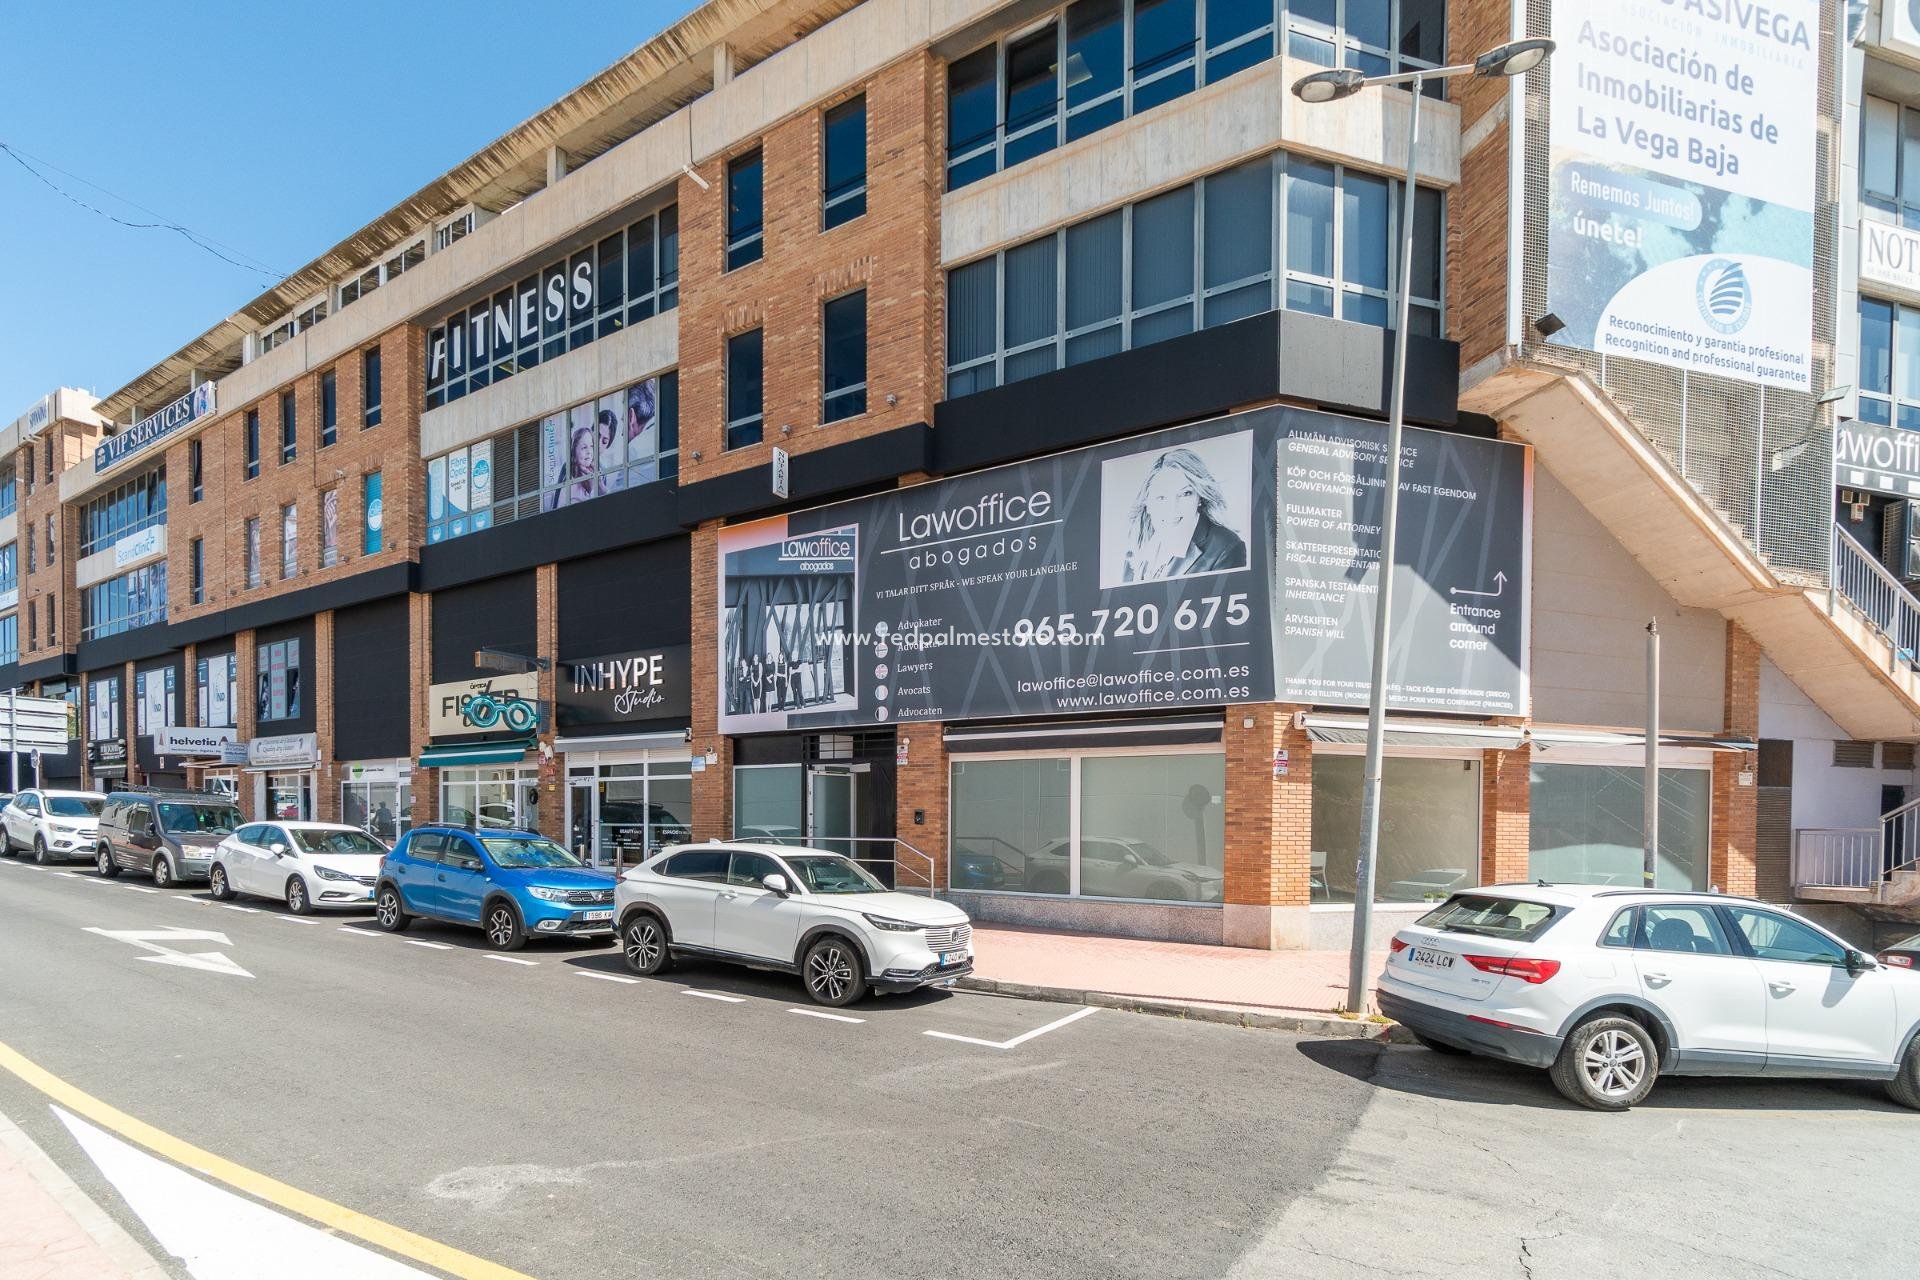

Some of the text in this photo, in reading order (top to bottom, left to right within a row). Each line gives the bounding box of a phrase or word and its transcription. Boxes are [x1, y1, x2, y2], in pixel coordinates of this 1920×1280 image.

[1577, 20, 1754, 95] Asociación de
[1577, 62, 1778, 144] Inmobiliarias de
[1577, 106, 1739, 176] La Vega Baja
[1571, 171, 1695, 222] Rememos Juntos!
[1573, 210, 1643, 248] únete!
[1868, 227, 1920, 276] NOT
[431, 261, 593, 380] FITNESS
[1609, 315, 1694, 343] Reconocimiento
[1696, 334, 1702, 347] y
[1748, 344, 1805, 365] profesional
[1605, 333, 1807, 383] Recognition and professional guarantee
[108, 433, 128, 459] VIP
[130, 396, 190, 448] SERVICES
[1288, 429, 1326, 442] ALLMÄN
[1328, 437, 1380, 452] ADVISORISK
[450, 456, 467, 468] Fibre
[1288, 442, 1330, 456] GENERAL
[1331, 450, 1377, 463] ADVISORY
[1287, 465, 1306, 477] KÖP
[1308, 469, 1331, 481] OCH
[1398, 483, 1410, 491] AV
[1412, 484, 1432, 494] FAST
[1434, 486, 1477, 500] EGENDOM
[1287, 479, 1364, 497] CONVEYANCING
[899, 491, 1051, 542] Lawoffice
[1286, 503, 1343, 519] FULLMAKTER
[1286, 516, 1382, 535] POWER OF ATTORNEY
[782, 538, 850, 557] Lawoffice
[909, 536, 1037, 570] abogados
[800, 561, 834, 572] abogados
[1286, 553, 1317, 565] FISCAL
[876, 561, 1078, 599] VI TALAR DITT SPRÅK WE SPEAK YOUR LANGUAGE
[1285, 577, 1379, 595] SPANSKA TESTAMENT
[1285, 590, 1345, 603] INHERITANCE
[1014, 592, 1250, 648] 965 720 675
[1285, 614, 1339, 626] ARVSKIFTEN
[1450, 603, 1501, 619] Entrance
[897, 617, 943, 631] Advokater
[1285, 626, 1345, 639] SPANISH WILL
[1450, 622, 1496, 635] arround
[897, 639, 942, 652] Advokater
[1449, 639, 1489, 650] corner
[574, 654, 664, 693] INHYPE
[897, 662, 933, 674] Lawyers
[1017, 664, 1250, 693] lawoffice@lawoffice.com.es
[1285, 677, 1308, 686] THANK
[1336, 681, 1354, 689] YOUR
[1355, 681, 1372, 689] TRUS
[614, 685, 665, 714] Studio
[897, 685, 931, 696] Avocats
[1057, 685, 1250, 708] www.lawoffice.com.es
[897, 706, 943, 718] Advocaten
[170, 736, 217, 746] helvetia
[1415, 950, 1435, 963] 2424
